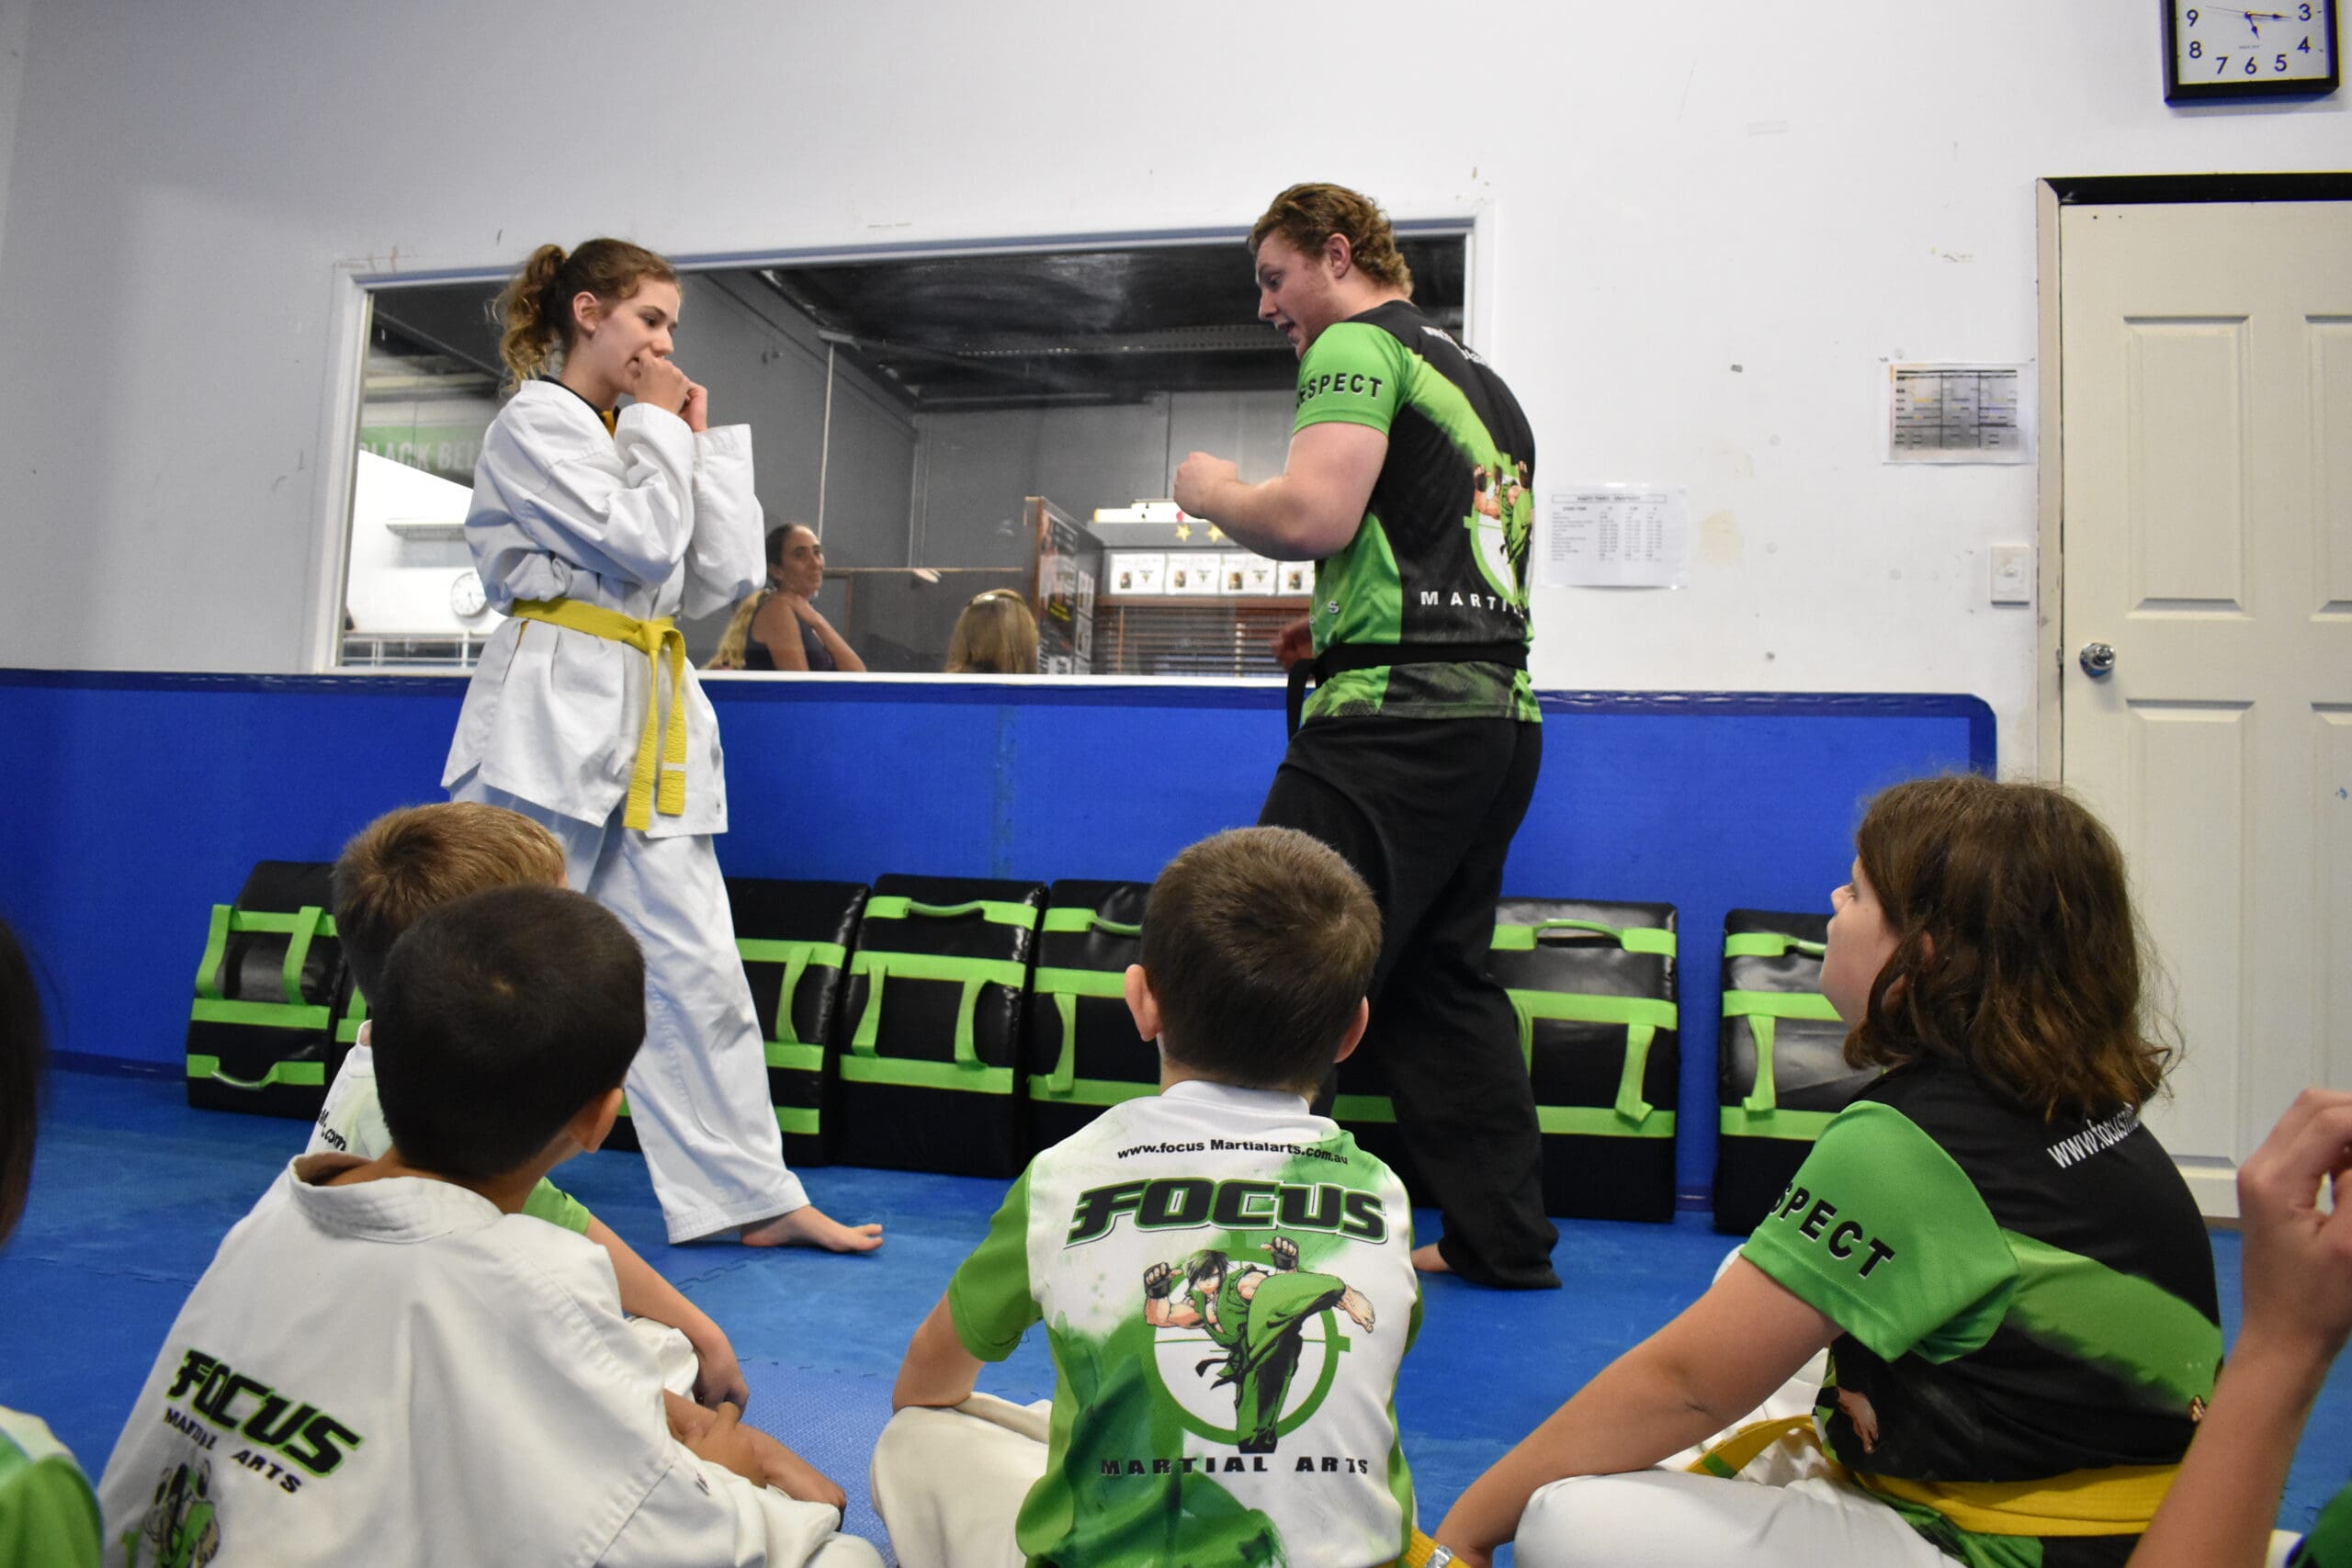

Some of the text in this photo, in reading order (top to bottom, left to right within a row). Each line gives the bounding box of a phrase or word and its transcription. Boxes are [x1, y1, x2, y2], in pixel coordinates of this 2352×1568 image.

[2187, 9, 2199, 27] 9
[2298, 4, 2312, 21] 3
[2189, 41, 2202, 59] 8
[2297, 36, 2311, 53] 4
[2215, 56, 2228, 74] 7
[2245, 56, 2256, 74] 6
[2274, 54, 2287, 72] 5
[1296, 372, 1383, 409] ESPECT
[1117, 1139, 1348, 1165] www.focus Martialarts.com.au
[1064, 1177, 1388, 1247] FOCUS
[165, 1349, 365, 1476] FOCUS
[232, 1449, 303, 1494] ARTS
[1101, 1456, 1368, 1476] MARTIAL ARTS
